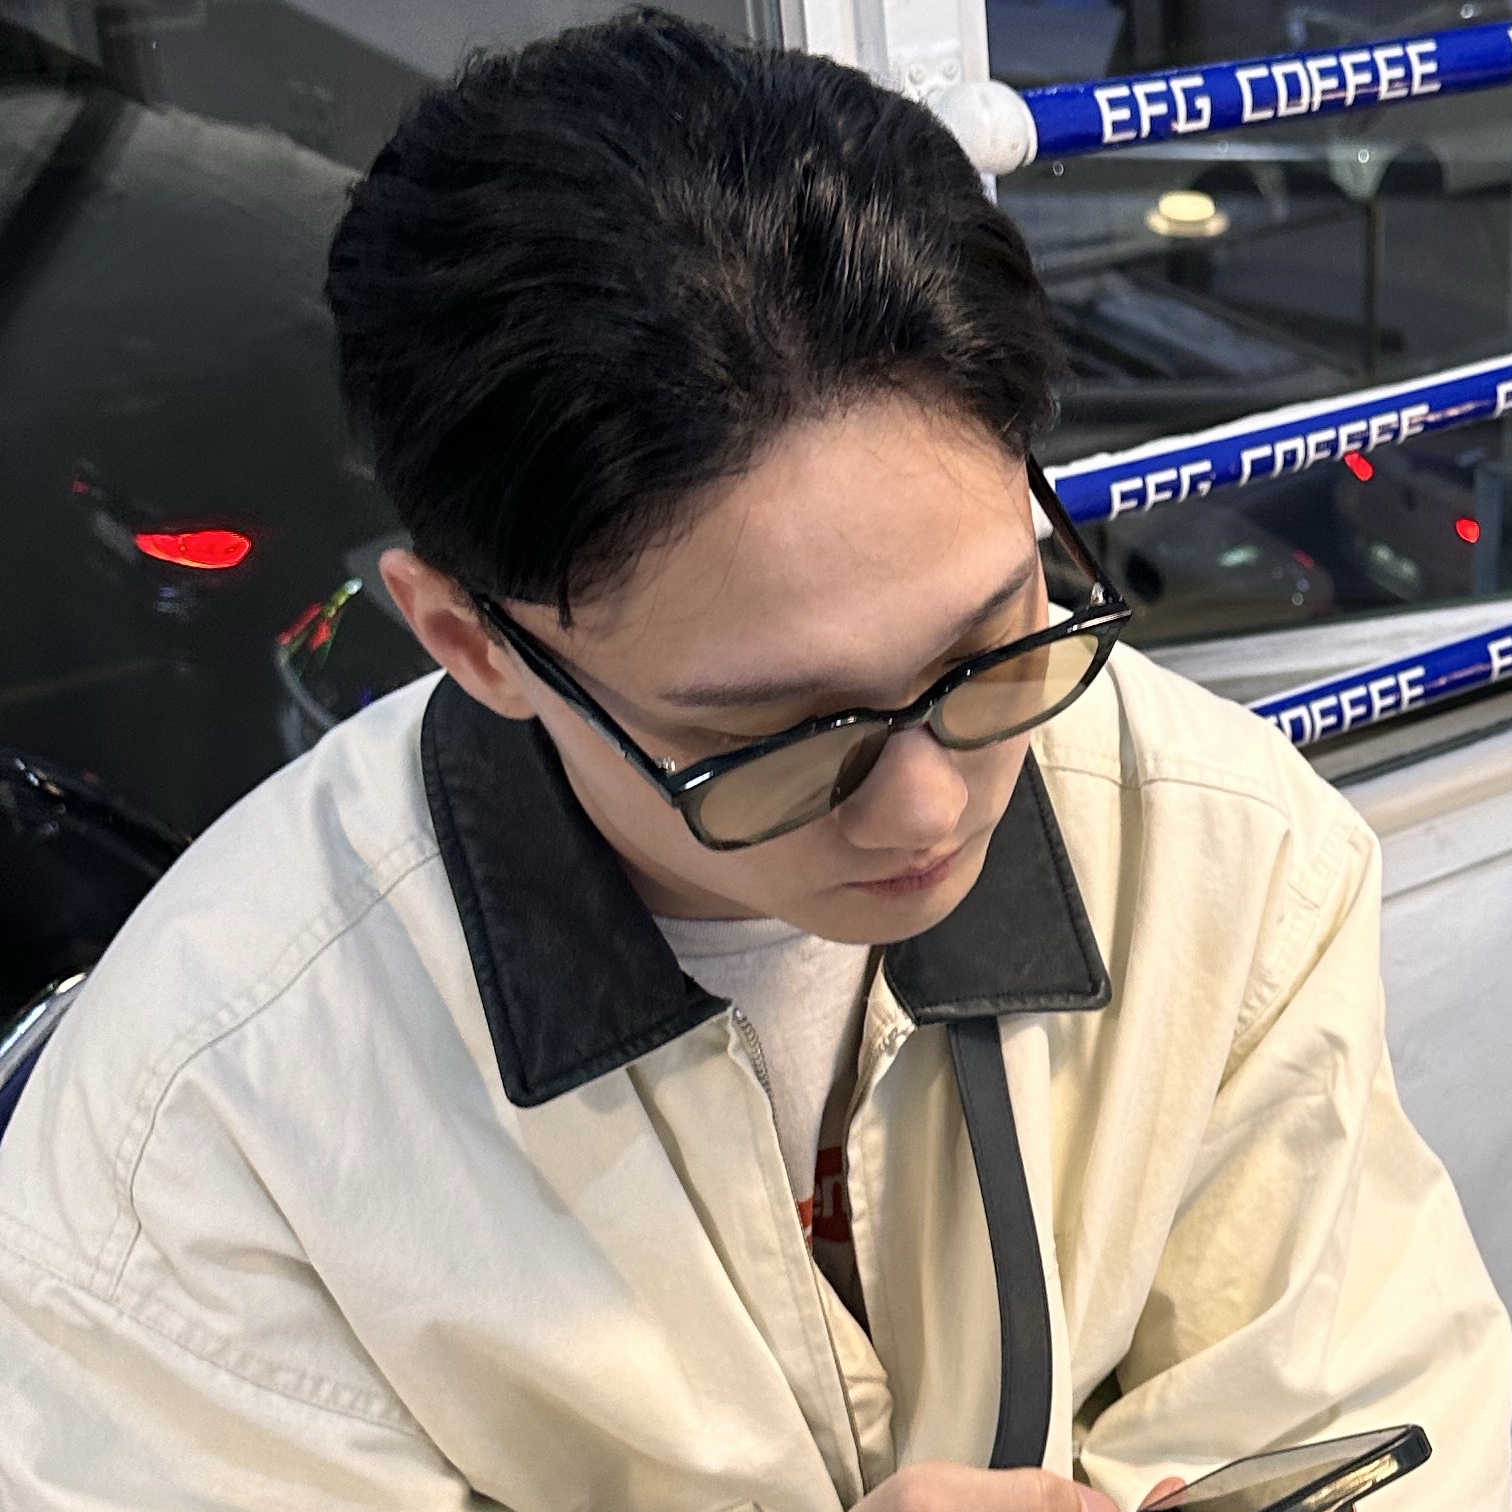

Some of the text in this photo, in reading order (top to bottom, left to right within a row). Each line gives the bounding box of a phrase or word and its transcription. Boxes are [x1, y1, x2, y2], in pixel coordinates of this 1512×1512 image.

[1094, 38, 1441, 143] EFG COFFEE
[1265, 664, 1426, 748] OFFEE
